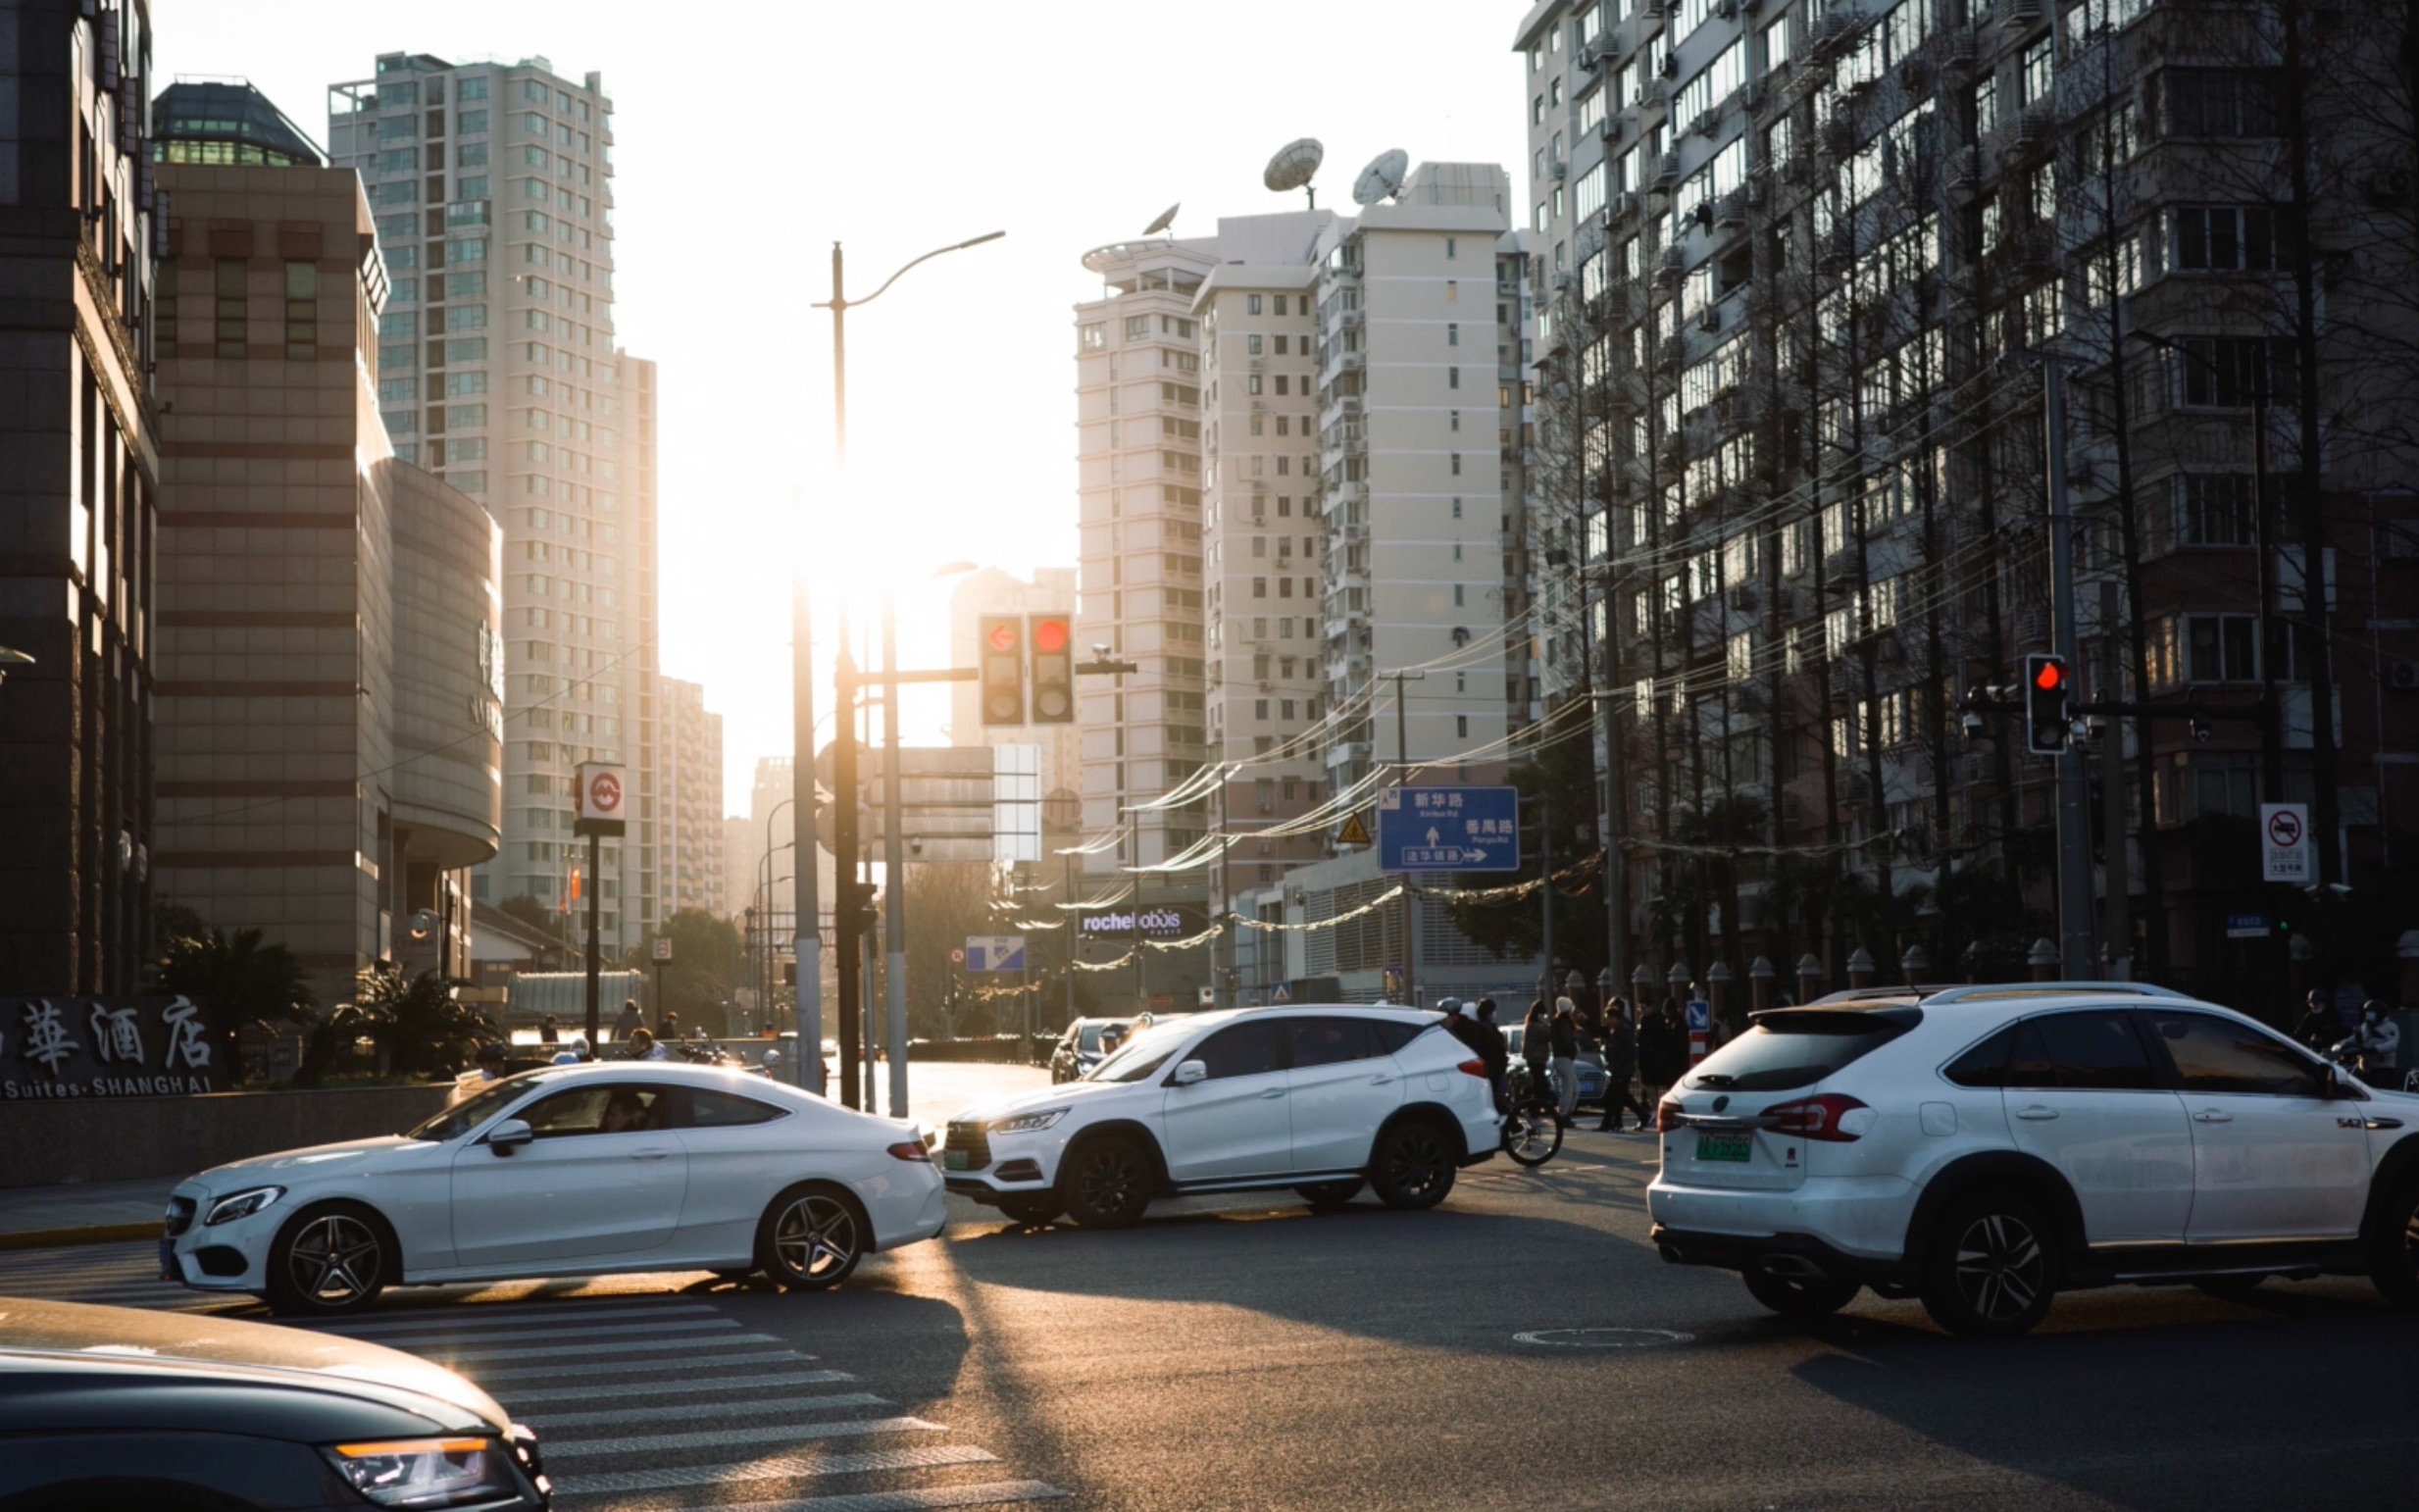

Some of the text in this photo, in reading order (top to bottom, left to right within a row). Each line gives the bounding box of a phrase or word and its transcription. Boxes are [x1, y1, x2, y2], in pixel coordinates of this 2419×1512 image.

[1414, 792, 1464, 808] 新华路
[1465, 819, 1514, 834] 番禺路
[0, 995, 211, 1076] 華酒店
